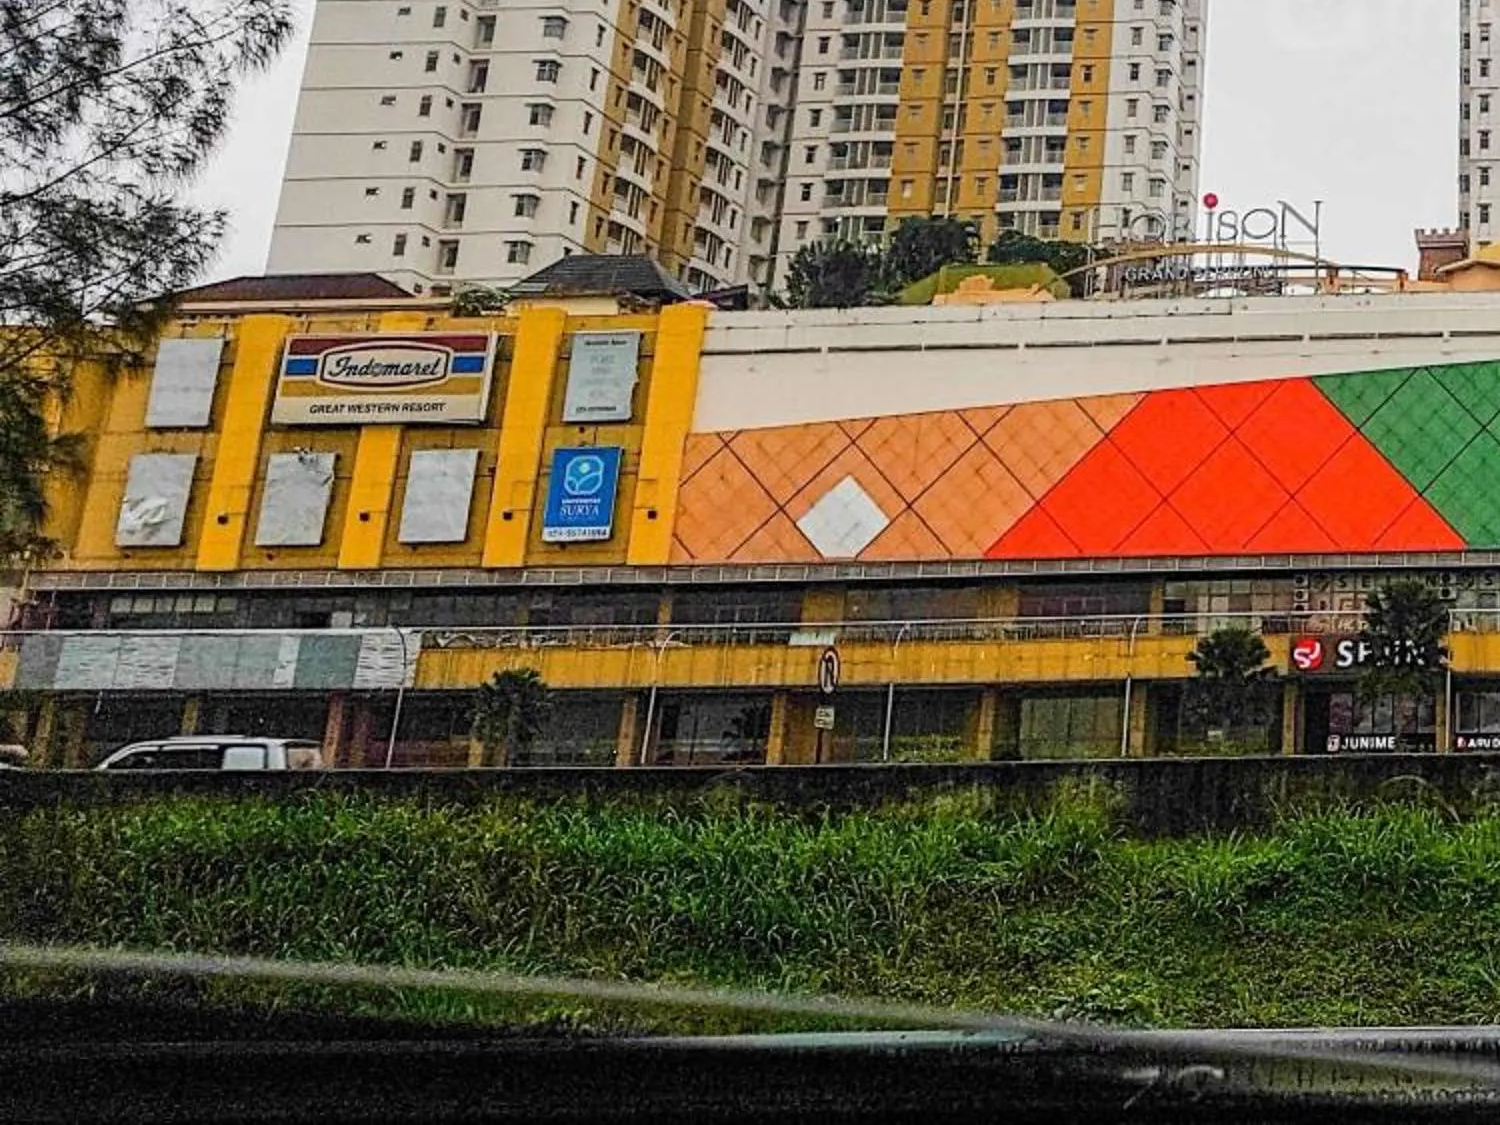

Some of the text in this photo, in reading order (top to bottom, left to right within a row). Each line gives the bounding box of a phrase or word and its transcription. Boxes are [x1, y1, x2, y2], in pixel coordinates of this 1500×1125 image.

[328, 356, 441, 377] Indomaret
[309, 402, 447, 414] GREAT WESTERN RESORT
[560, 505, 599, 516] SURYA
